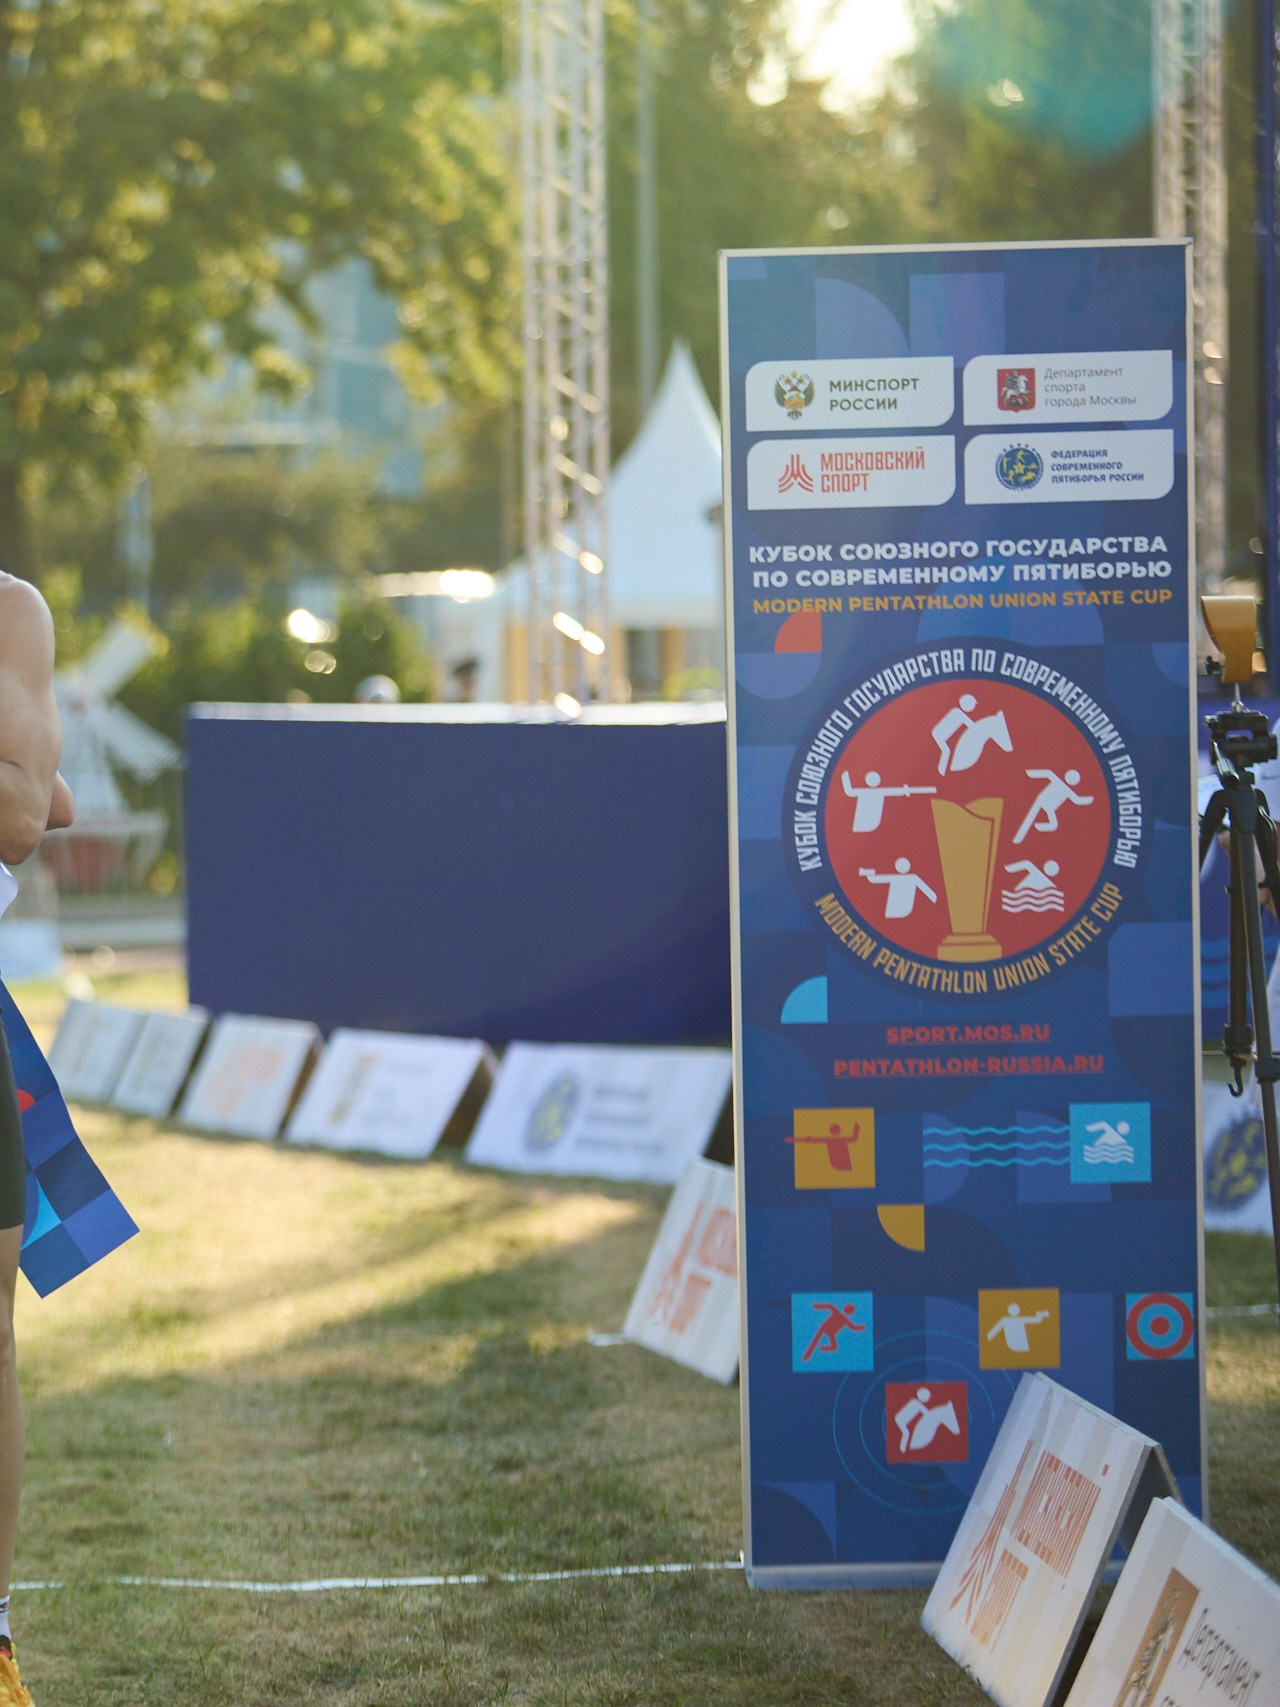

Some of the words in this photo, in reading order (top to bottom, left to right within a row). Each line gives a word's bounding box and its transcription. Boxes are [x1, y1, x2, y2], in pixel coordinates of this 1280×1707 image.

[829, 376, 920, 393] МИНСПОРТ
[1044, 367, 1124, 383] Департамент
[1044, 382, 1086, 395] спорта
[829, 396, 899, 412] РОССИИ
[1044, 396, 1087, 409] города
[1089, 394, 1137, 406] Москвы
[820, 446, 925, 471] МОСКОВСКИЙ
[1050, 449, 1108, 460] ФЕДЕРАЦИЯ
[1051, 461, 1123, 472] СОВРЕМЕННОГО
[1051, 473, 1107, 484] ПЯТИБОРЬЯ
[1109, 472, 1145, 482] РОССИИ
[821, 472, 869, 493] СПОРТ
[748, 544, 833, 564] КУБОК
[839, 540, 978, 562] СОЮЗНОГО
[986, 535, 1168, 559] ГОСУДАРСТВА
[753, 570, 789, 588] ПО
[795, 565, 1006, 587] СОВРЕМЕННОМУ
[1012, 560, 1172, 582] ПЯТИБОРЬЮ
[753, 597, 843, 615] MODERN
[849, 594, 985, 612] PENTATHLON
[990, 592, 1056, 609] UNION
[1062, 590, 1126, 607] STATE
[1130, 588, 1173, 604] CUP
[971, 648, 996, 673] ПО
[843, 648, 965, 719] ГОСУДАРСТВА
[1000, 652, 1125, 755] СОВРЕМЕННОМУ
[799, 709, 854, 806] СОЮЗНОГО
[1109, 754, 1142, 869] ПЯТИБОРЬЮ
[794, 809, 823, 872] КУБОК
[814, 892, 875, 961] MODERN
[872, 950, 989, 995] PENTATHLON
[993, 953, 1050, 991] UNION
[1049, 914, 1102, 967] STATE
[1093, 882, 1124, 932] CUP
[886, 1025, 1051, 1045] SPORT.MOS.RU
[834, 1056, 1104, 1077] PENTATHLON-RUSSIA.RU
